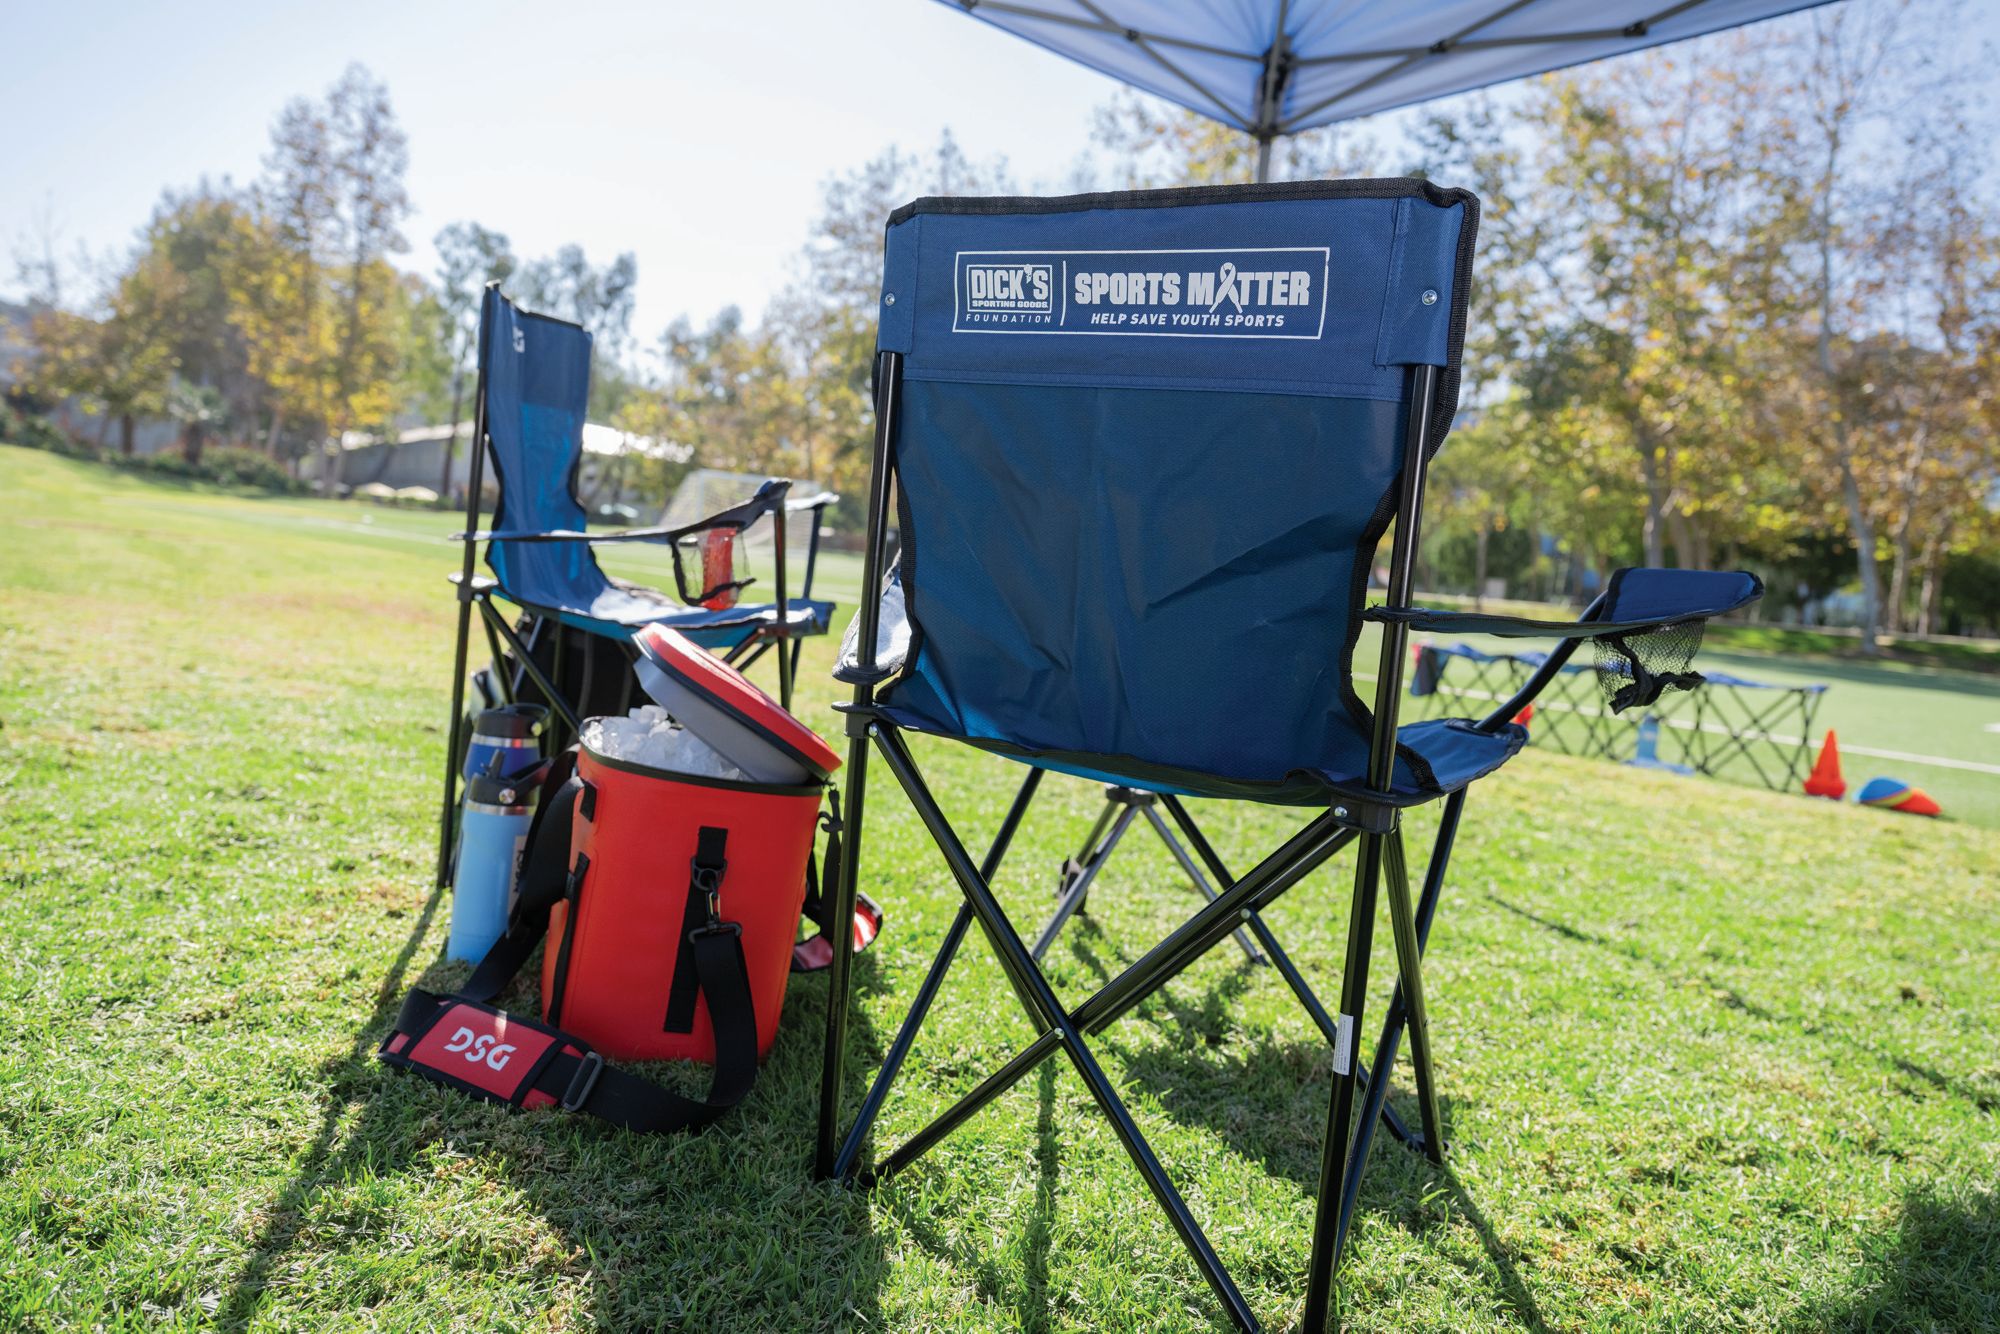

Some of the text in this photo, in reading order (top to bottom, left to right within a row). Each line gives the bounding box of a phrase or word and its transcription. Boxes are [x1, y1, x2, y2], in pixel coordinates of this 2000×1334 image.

[971, 264, 1048, 300] DICK'S
[1075, 262, 1311, 313] SPORTS MATTER
[972, 300, 1016, 308] SPORTING
[966, 314, 1051, 323] FOUNDATION
[1091, 313, 1285, 326] HELP SAVE YOUTH SPORTS
[443, 1026, 517, 1072] DSG
